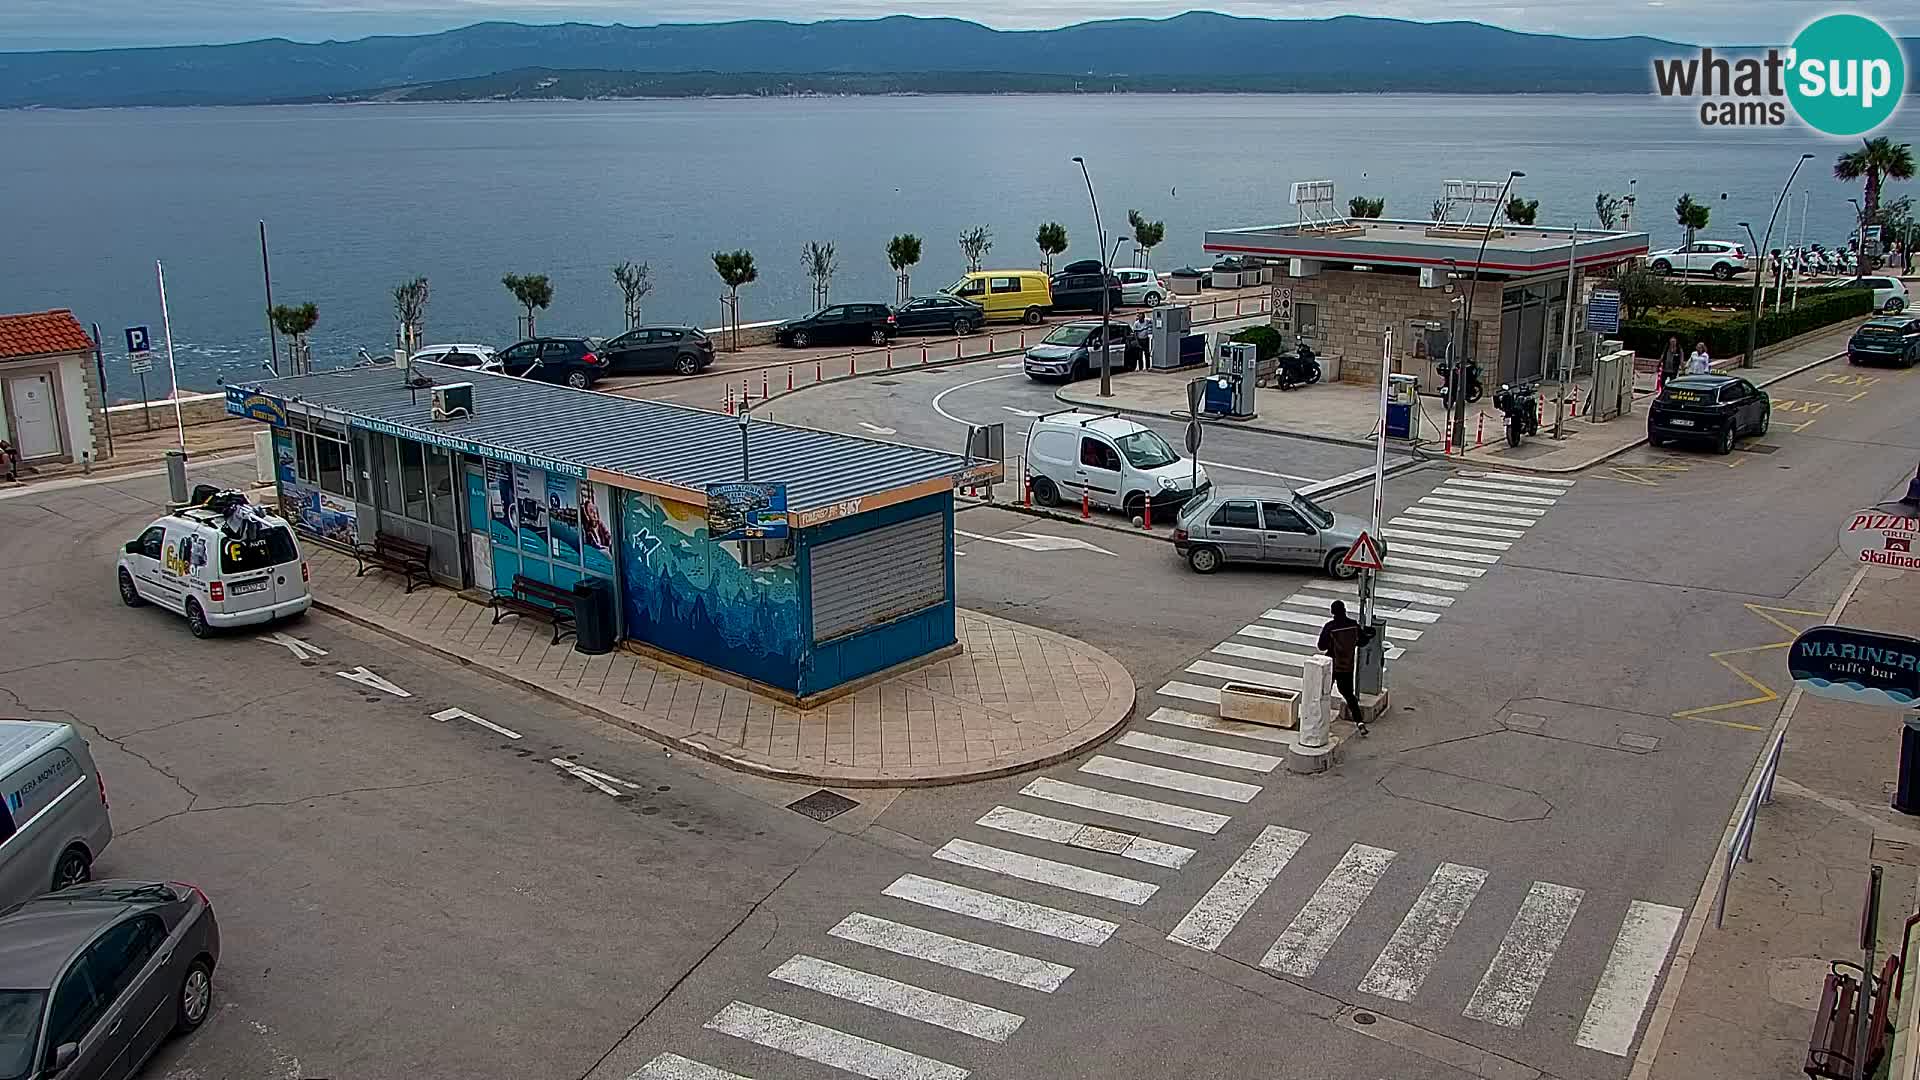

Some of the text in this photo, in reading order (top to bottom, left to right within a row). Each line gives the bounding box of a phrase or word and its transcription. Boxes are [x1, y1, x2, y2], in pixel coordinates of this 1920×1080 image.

[131, 330, 143, 349] P
[1815, 374, 1881, 386] TAXI
[397, 428, 437, 444] AUTOBUSNA
[437, 435, 469, 452] POSTAJA
[478, 445, 493, 457] BUS
[494, 449, 527, 465] STATION
[528, 456, 555, 471] TICKET
[556, 462, 583, 477] OFFICE
[1882, 530, 1917, 540] GRILL
[1800, 641, 1920, 673] MARINER
[1829, 662, 1897, 679] caffe bar
